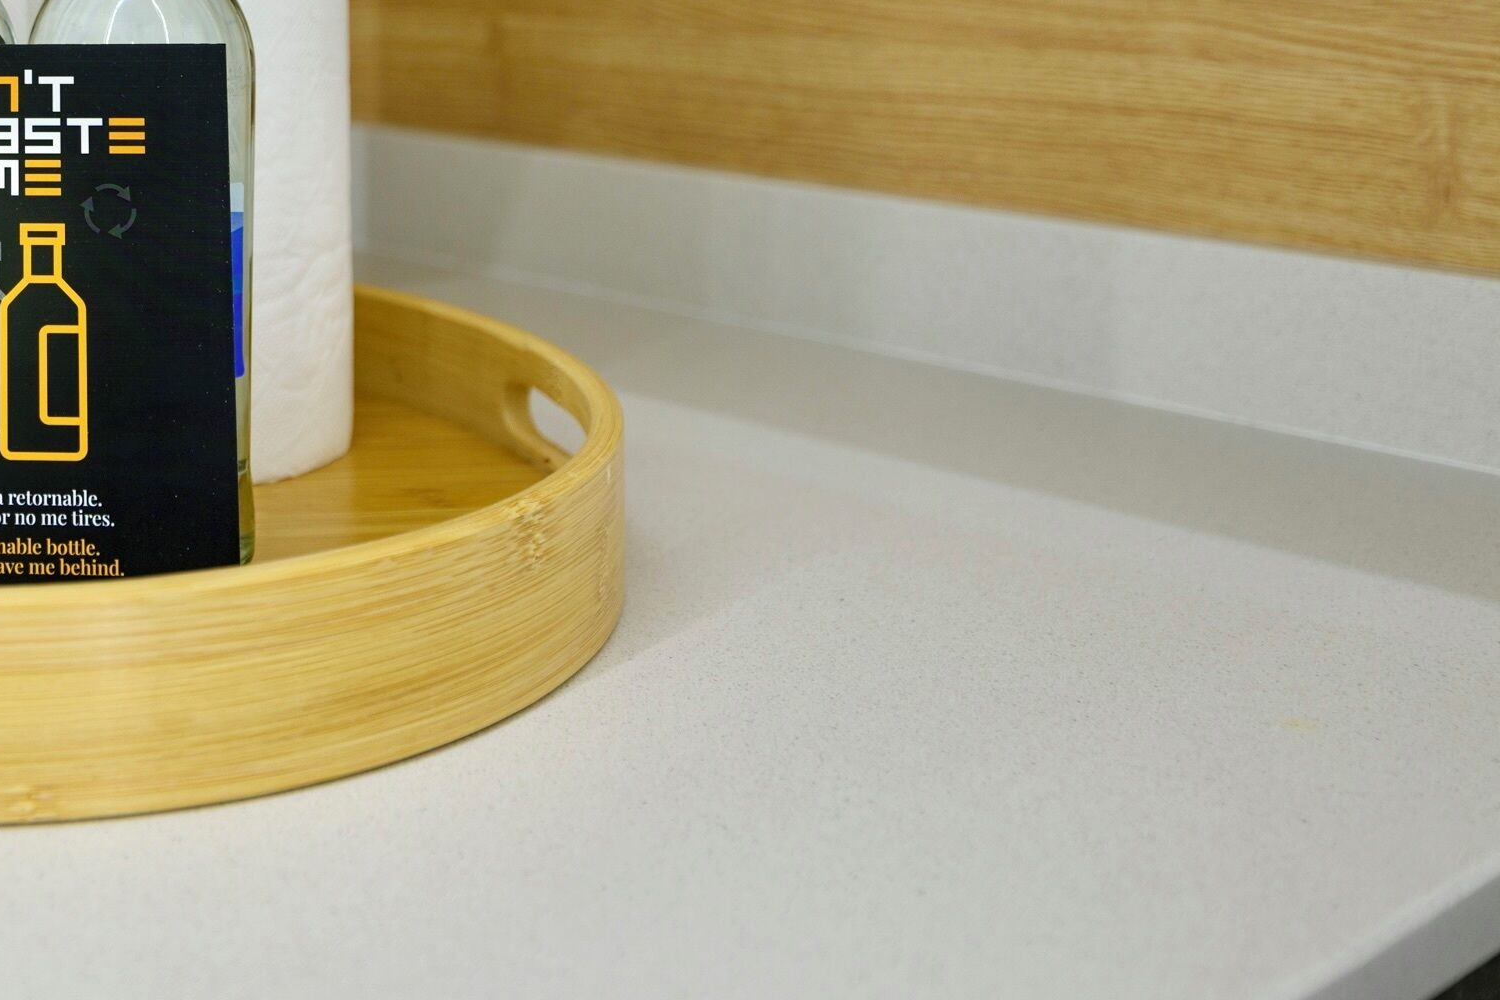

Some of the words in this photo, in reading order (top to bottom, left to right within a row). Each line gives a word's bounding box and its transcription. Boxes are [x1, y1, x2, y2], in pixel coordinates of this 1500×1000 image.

[8, 489, 103, 507] retornable.
[14, 512, 37, 526] no
[40, 513, 68, 527] me
[72, 509, 115, 527] tires.
[46, 538, 101, 556] bottle.
[28, 562, 55, 576] me
[60, 558, 125, 577] behind.
